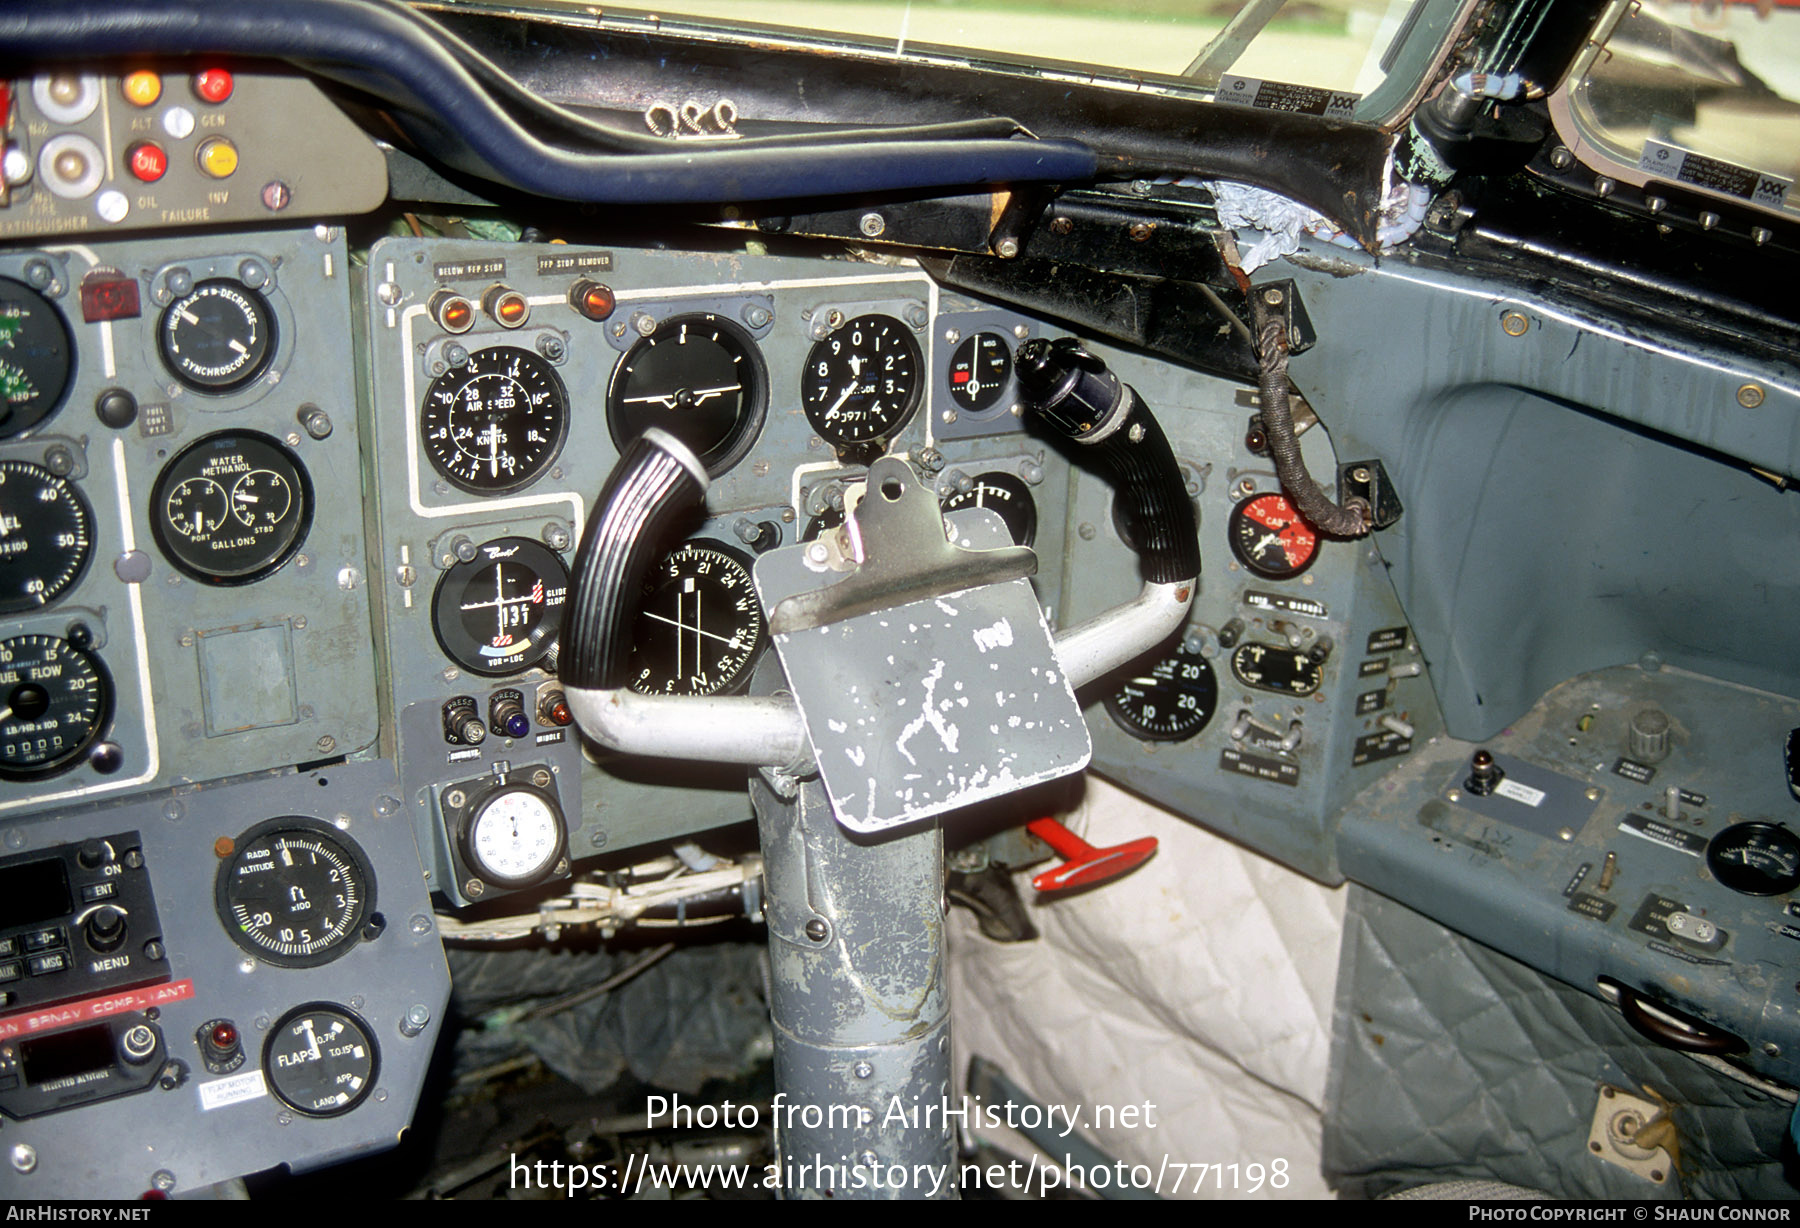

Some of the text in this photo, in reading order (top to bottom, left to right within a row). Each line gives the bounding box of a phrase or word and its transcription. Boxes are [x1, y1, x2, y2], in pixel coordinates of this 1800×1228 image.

[131, 117, 152, 130] ALT
[201, 114, 226, 127] GEN
[137, 157, 162, 173] OIL
[138, 196, 158, 209] OIL
[208, 191, 229, 204] INV
[161, 207, 210, 222] FAILURE
[556, 258, 575, 268] STOP
[577, 255, 610, 267] REMOVED
[438, 266, 464, 277] BELOW
[484, 263, 504, 273] STOP
[6, 308, 20, 318] 60
[167, 291, 200, 331] INCREASE
[220, 287, 258, 326] DECREASE
[852, 331, 863, 346] 0
[875, 336, 880, 352] 1
[831, 340, 841, 356] 9
[181, 351, 252, 377] SYNCHROSCOPE
[818, 361, 829, 377] 8
[884, 355, 894, 370] 2
[956, 363, 969, 371] GPS
[508, 366, 520, 378] 14
[6, 376, 20, 386] 90
[885, 379, 895, 394] 3
[12, 391, 30, 402] 120
[442, 392, 454, 405] 10
[465, 388, 480, 401] 28
[500, 386, 514, 398] 32
[818, 386, 829, 402] 7
[532, 394, 544, 405] 16
[466, 401, 483, 412] AIR
[871, 400, 882, 415] 4
[439, 427, 447, 439] 8
[459, 427, 473, 440] 24
[476, 433, 508, 446] KNTS
[527, 429, 539, 442] 18
[210, 454, 244, 467] WATER
[454, 450, 462, 462] 6
[501, 456, 516, 469] 20
[202, 462, 252, 477] METHANOL
[472, 460, 480, 471] 4
[246, 478, 256, 487] 20
[271, 478, 281, 487] 25
[40, 488, 58, 501] 40
[182, 488, 192, 496] 20
[205, 487, 215, 495] 25
[174, 498, 183, 506] 15
[239, 504, 248, 512] 10
[1277, 502, 1287, 511] 15
[1256, 508, 1266, 518] 10
[254, 526, 275, 535] STBD
[1248, 527, 1255, 537] 5
[58, 534, 75, 547] 50
[191, 533, 212, 543] PORT
[211, 536, 257, 551] GALLONS
[669, 565, 679, 577] S
[698, 562, 711, 575] 21
[27, 579, 44, 593] 60
[720, 573, 737, 589] 24
[546, 587, 567, 598] GLIDE
[45, 650, 58, 661] 15
[488, 654, 524, 666] VOR LOC
[717, 655, 733, 672] 33
[0, 672, 20, 684] UEL
[31, 664, 62, 680] FLOW
[1182, 664, 1200, 679] 20
[69, 678, 85, 690] 20
[691, 672, 708, 690] N
[494, 691, 520, 702] PRESS
[1177, 693, 1197, 710] 20
[447, 698, 473, 710] PRESS
[67, 712, 82, 723] 24
[1142, 704, 1156, 719] 10
[6, 723, 36, 735] LB/HR
[448, 734, 458, 743] TO
[246, 849, 271, 860] RADIO
[311, 852, 316, 864] 1
[104, 864, 122, 876] ON
[239, 861, 275, 875] ALTITUDE
[329, 869, 340, 882] 2
[95, 883, 113, 896] ENT
[290, 886, 307, 901] ft
[335, 894, 346, 908] 3
[1657, 899, 1675, 909] FAST
[253, 912, 272, 927] 20
[323, 917, 334, 931] 4
[280, 928, 294, 942] 10
[301, 929, 311, 943] 5
[42, 955, 63, 970] MSG
[92, 955, 130, 973] MENU
[91, 984, 188, 1015] COMPLIANT
[293, 1025, 303, 1036] UP
[207, 1052, 246, 1073] TO TEST
[277, 1048, 316, 1068] FLAPS
[42, 1070, 110, 1093] SELECTED ALTITUDE
[313, 1095, 336, 1109] LAND
